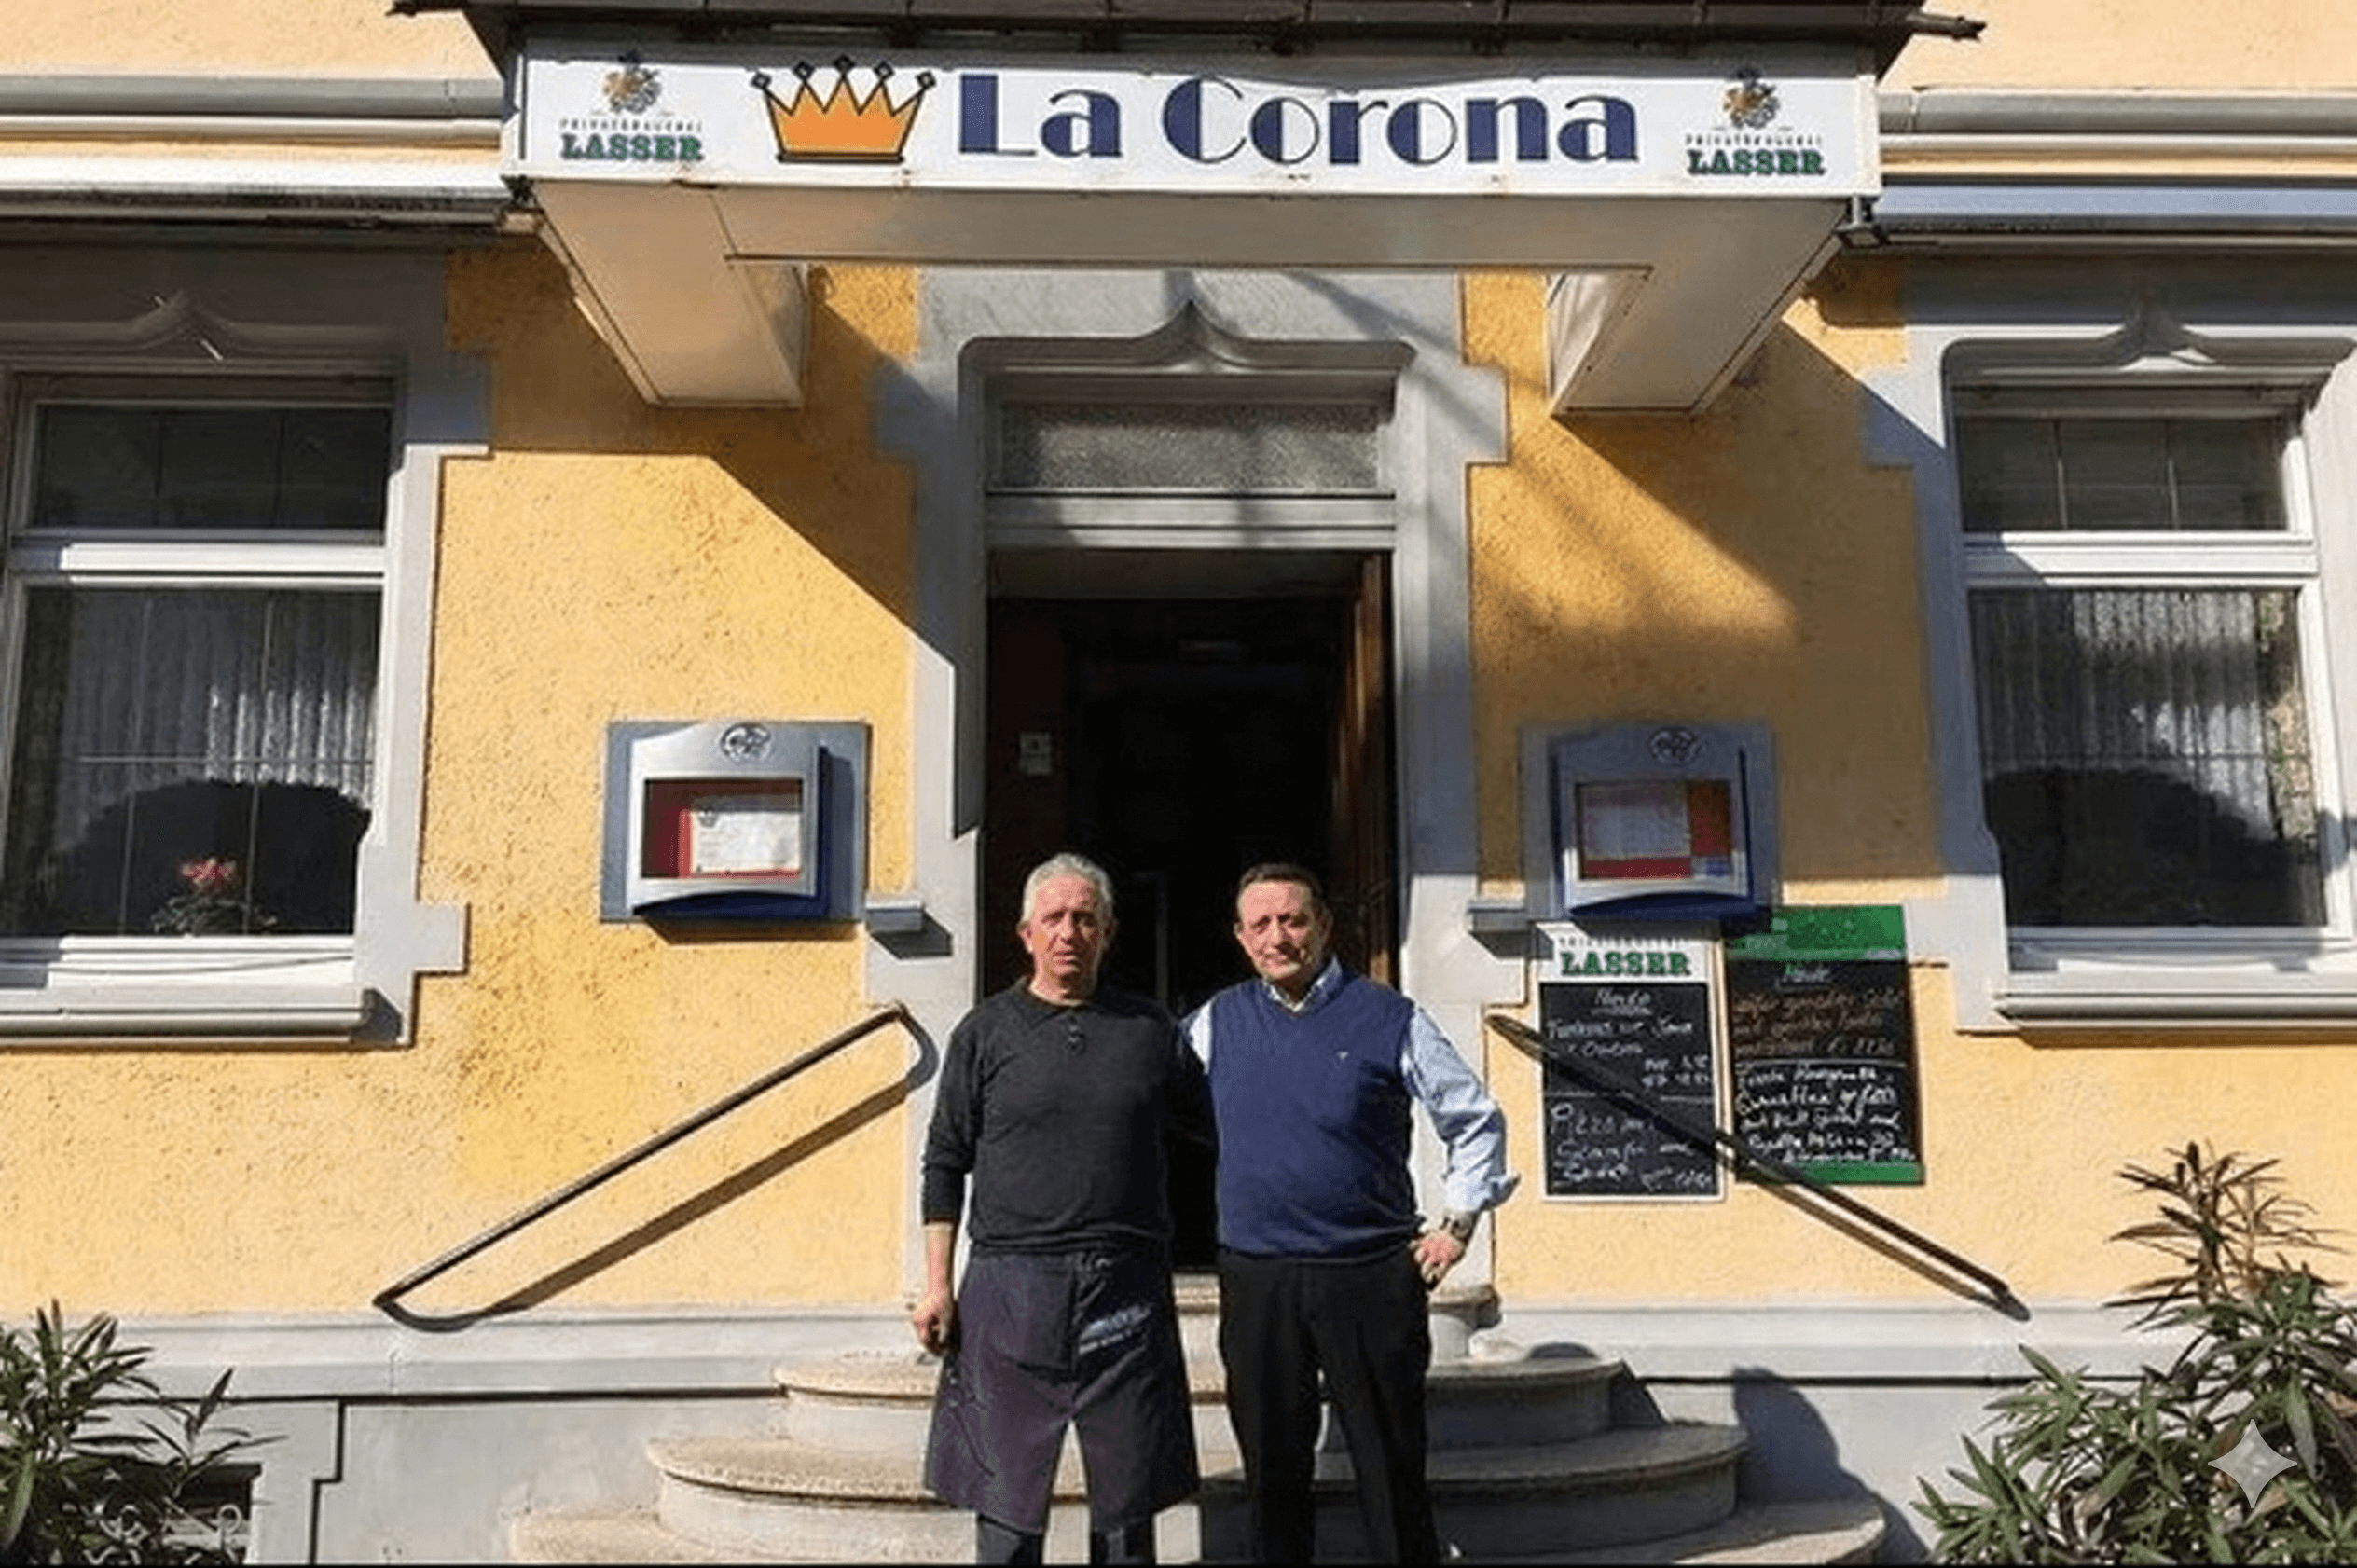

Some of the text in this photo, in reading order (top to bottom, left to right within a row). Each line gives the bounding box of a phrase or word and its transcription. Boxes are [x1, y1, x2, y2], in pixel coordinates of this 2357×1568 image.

[958, 73, 1639, 165] La Corona
[560, 133, 705, 161] LASSER
[1687, 148, 1826, 176] LASSER
[1560, 952, 1691, 976] LASSER
